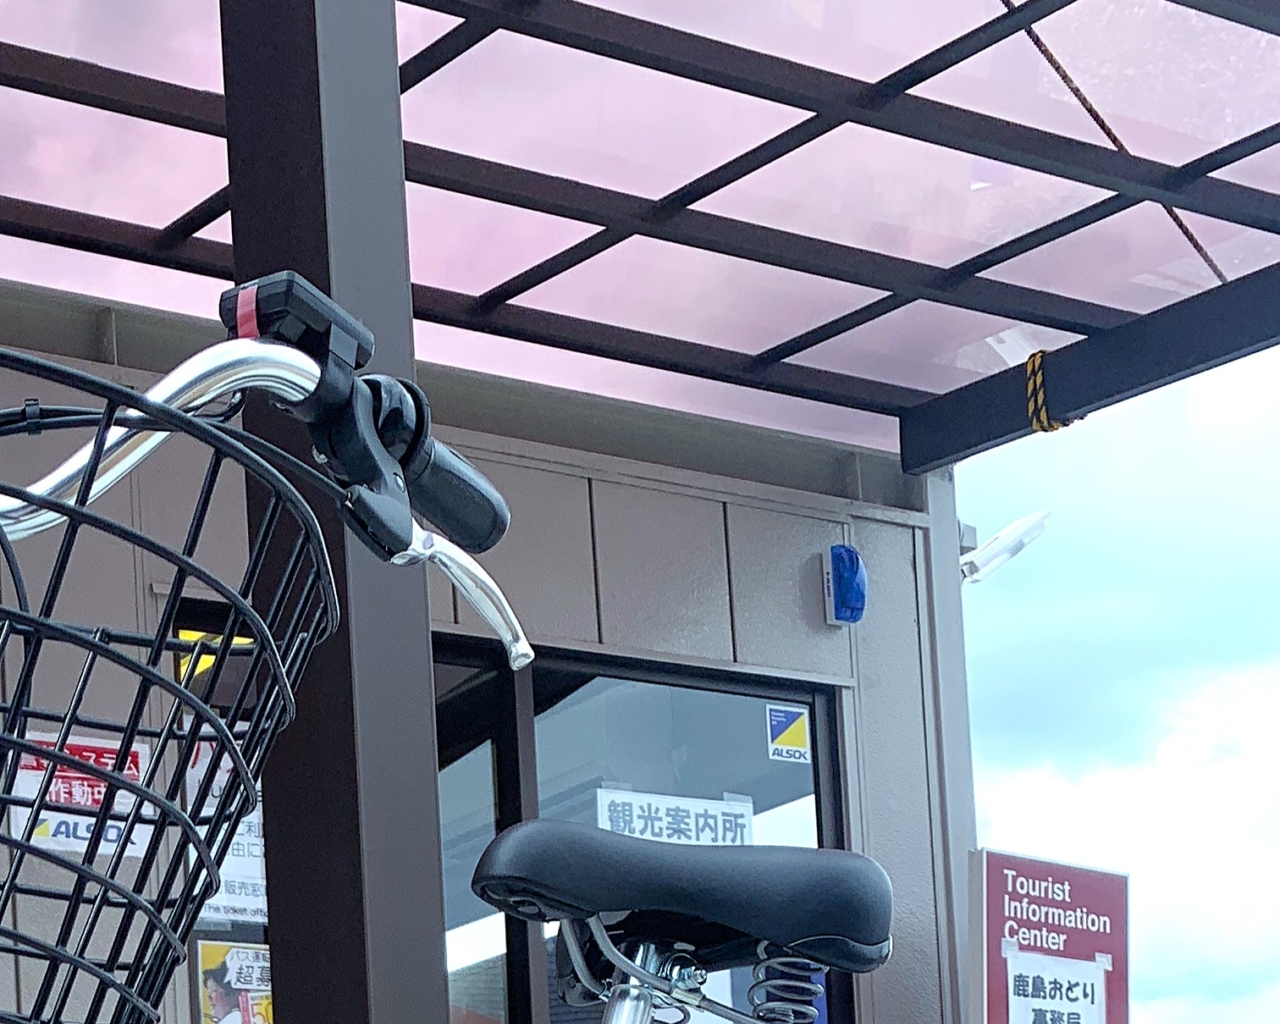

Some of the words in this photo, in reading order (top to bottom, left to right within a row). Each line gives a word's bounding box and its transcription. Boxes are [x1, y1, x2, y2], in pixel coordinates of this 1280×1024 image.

[772, 747, 807, 760] ALSOK
[607, 799, 746, 845] 観光案内所
[1003, 869, 1071, 902] Tourist
[1004, 895, 1111, 934] Information
[1004, 921, 1066, 950] Center
[1013, 972, 1095, 1005] 鹿島おどり
